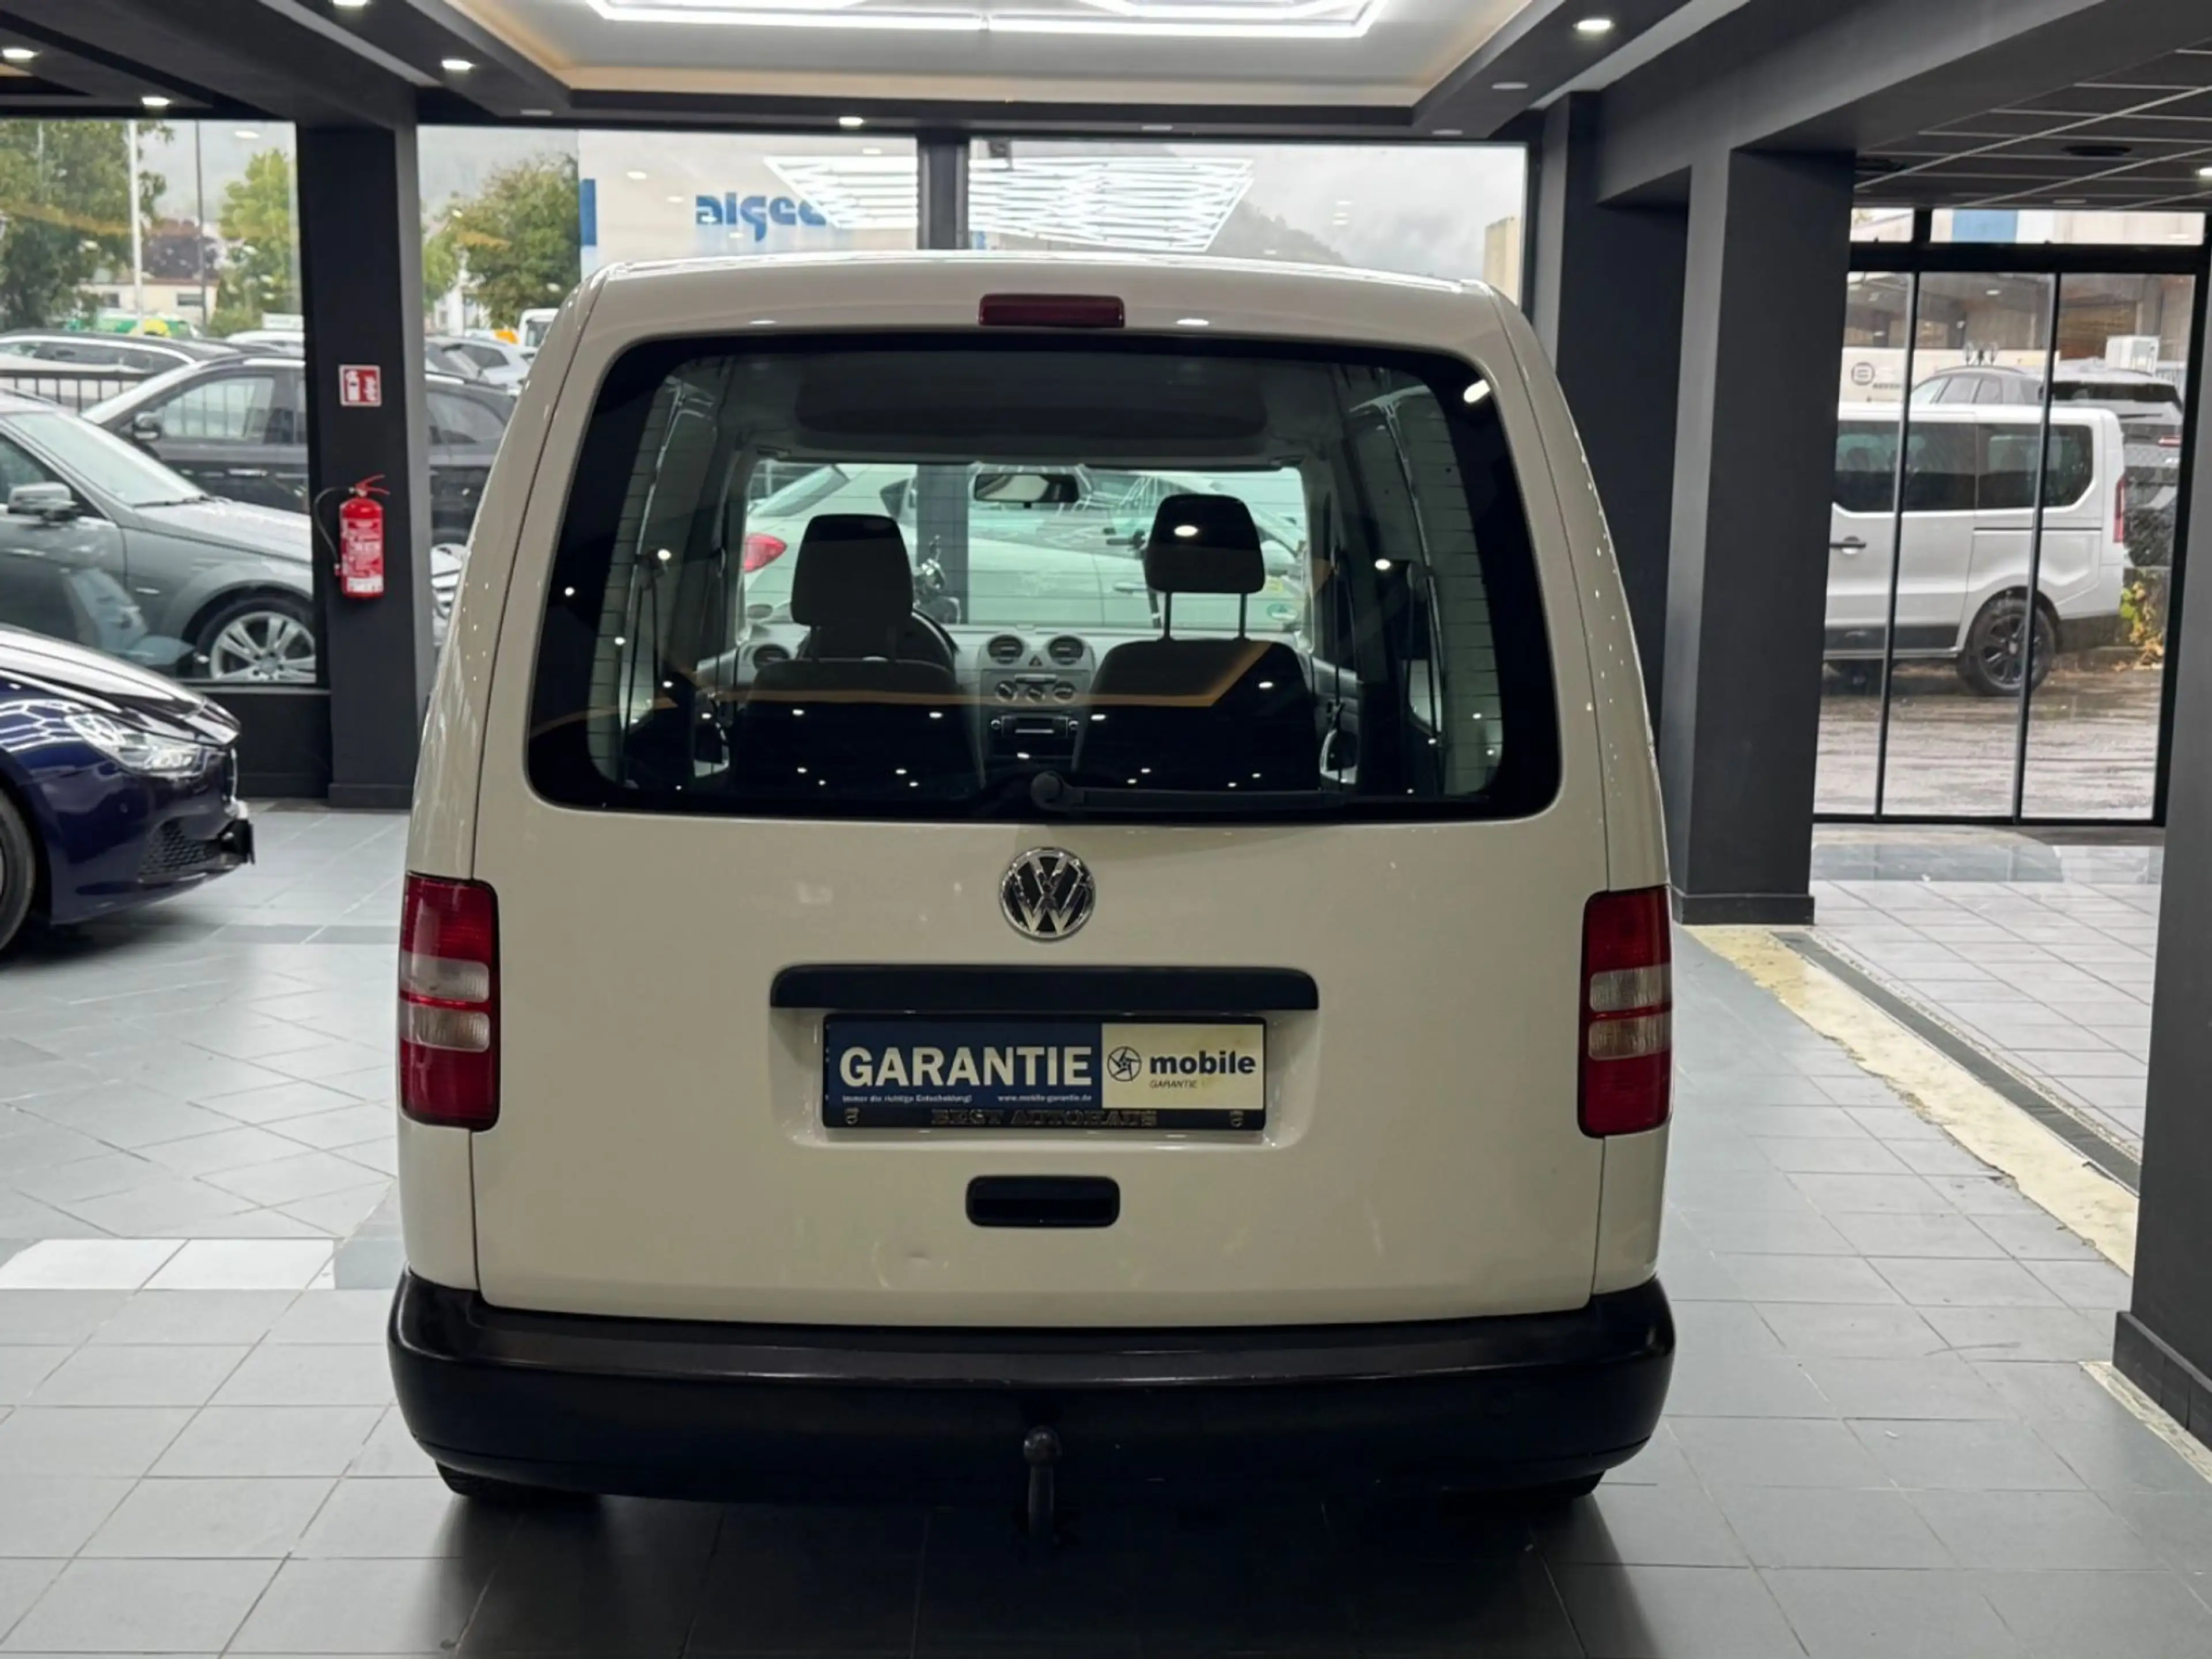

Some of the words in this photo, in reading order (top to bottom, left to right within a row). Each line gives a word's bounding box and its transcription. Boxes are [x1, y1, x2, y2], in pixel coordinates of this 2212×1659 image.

[695, 191, 827, 243] algec
[1001, 848, 1094, 940] VW
[840, 1046, 1092, 1087] GARANTIE
[1149, 1050, 1256, 1075] mobile
[1150, 1079, 1198, 1089] GARANTIE
